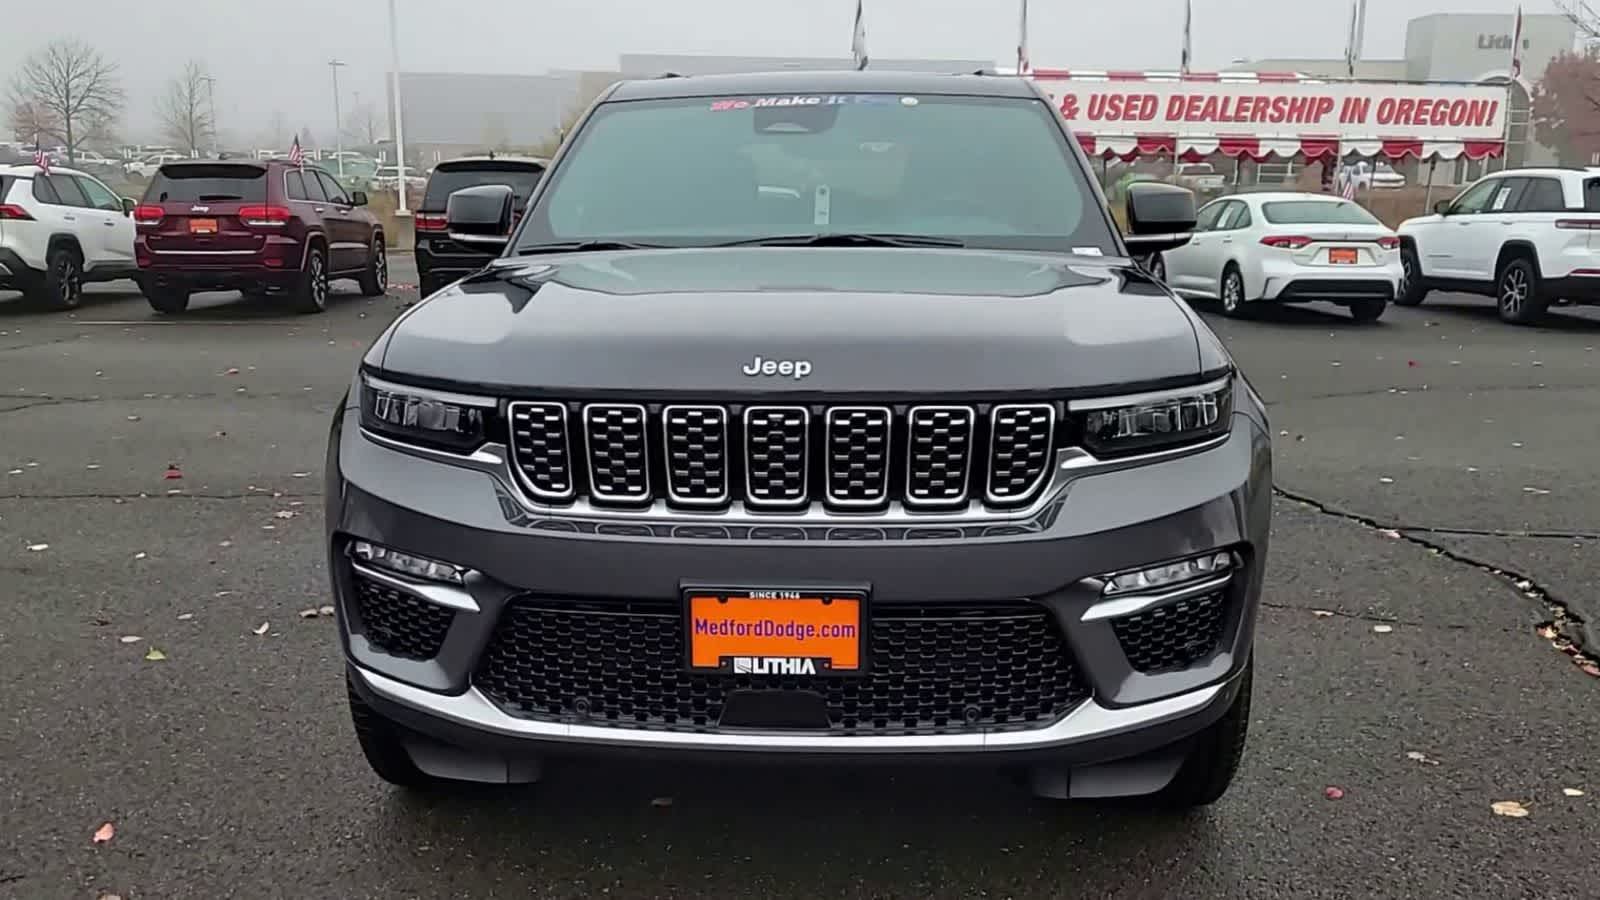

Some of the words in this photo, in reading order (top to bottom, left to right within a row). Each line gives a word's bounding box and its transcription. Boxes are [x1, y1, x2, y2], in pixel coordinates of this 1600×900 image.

[754, 95, 822, 107] Make
[1060, 93, 1080, 121] &
[1087, 93, 1160, 122] USED
[1165, 94, 1335, 125] DEALERSHIP
[1338, 96, 1372, 125] IN
[1376, 97, 1499, 127] OREGON!
[742, 356, 812, 379] Jeep
[749, 591, 777, 599] SINCE
[695, 618, 856, 640] MedfordDodge.com
[753, 657, 816, 675] LITHIA
